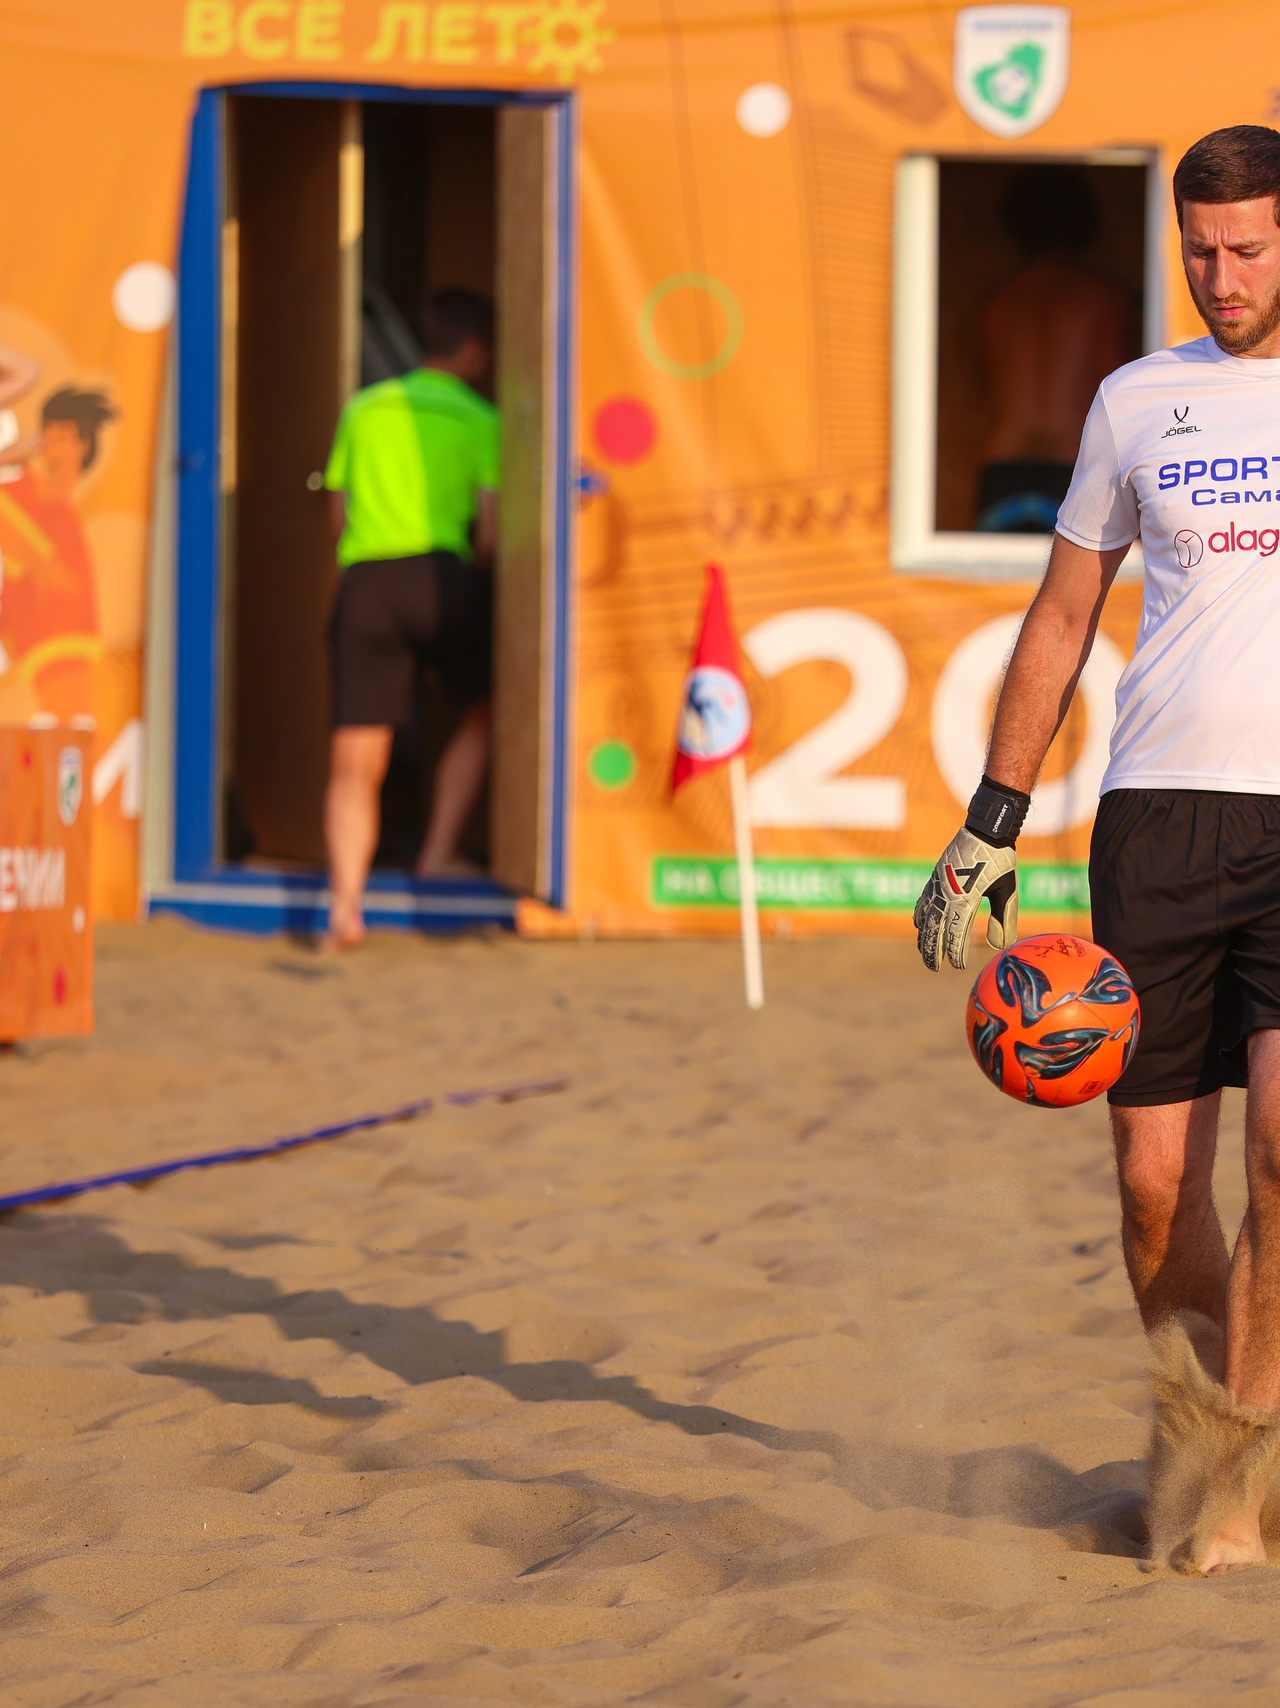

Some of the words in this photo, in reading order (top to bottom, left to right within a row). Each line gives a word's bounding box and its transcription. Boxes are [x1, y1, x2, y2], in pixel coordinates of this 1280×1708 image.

[182, 0, 344, 63] ВСЕ
[1160, 425, 1202, 439] JÖGEL
[992, 803, 1009, 834] COMFORT
